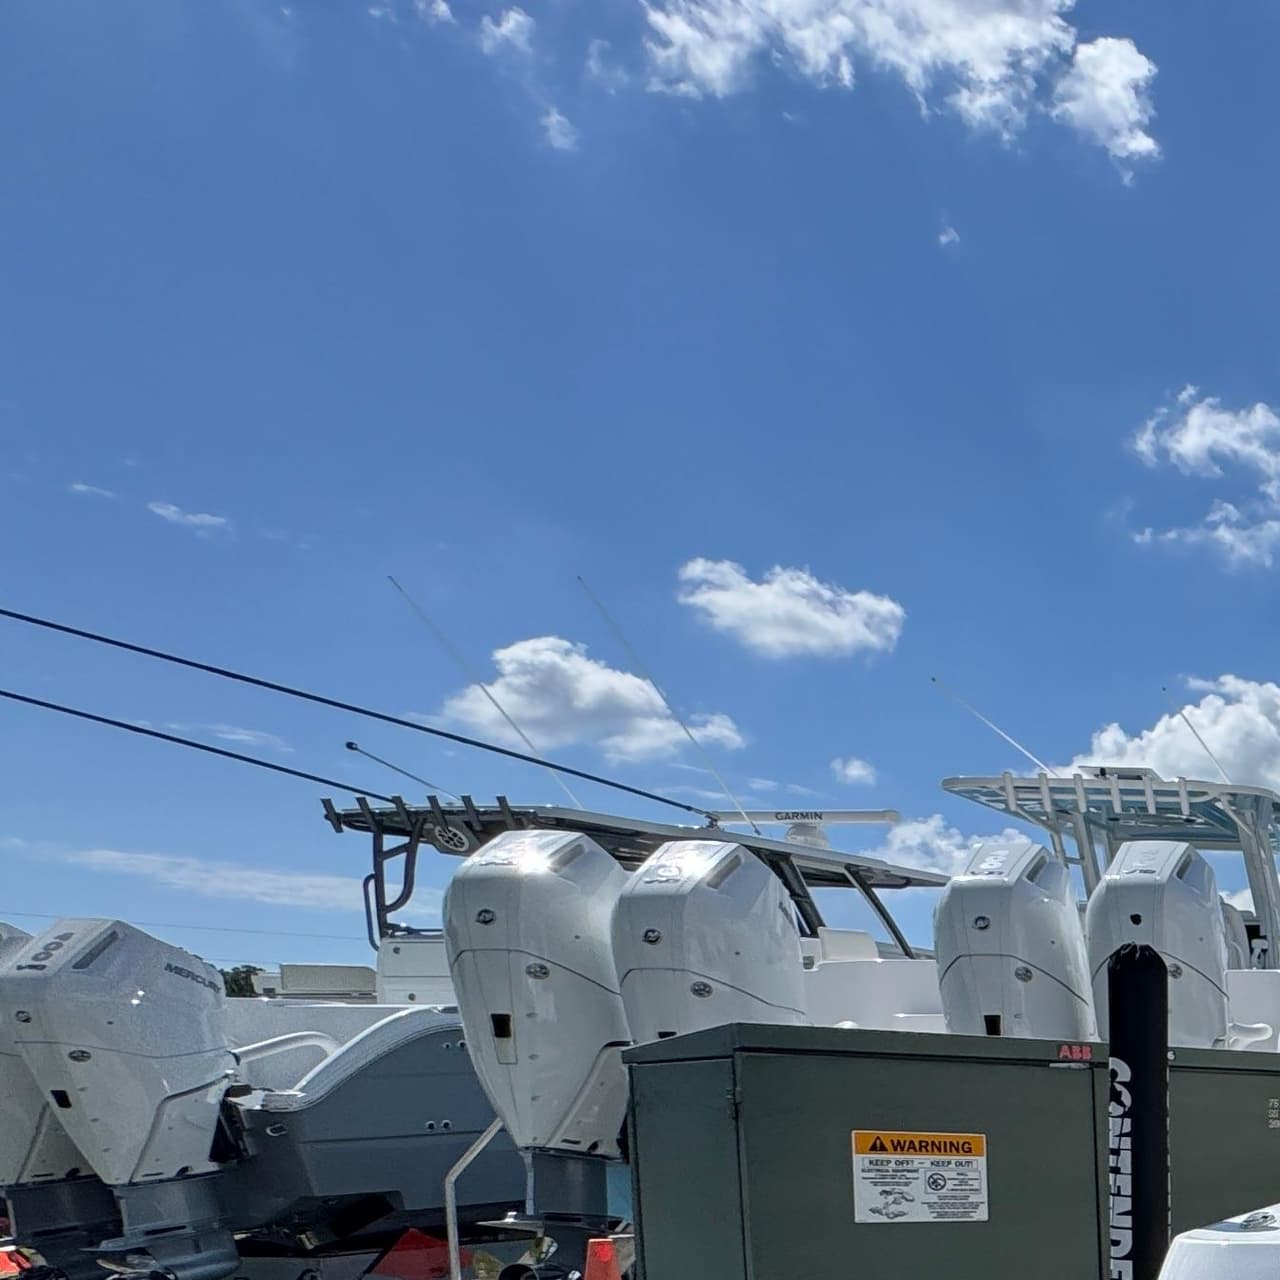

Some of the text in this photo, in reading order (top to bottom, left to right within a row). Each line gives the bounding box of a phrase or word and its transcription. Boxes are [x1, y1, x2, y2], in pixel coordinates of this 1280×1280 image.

[775, 811, 823, 821] GARMIN
[163, 962, 221, 993] MERCURY
[1059, 1044, 1093, 1061] ABB
[891, 1139, 973, 1154] WARNING
[930, 1160, 952, 1168] KEEP
[954, 1160, 973, 1168] OUT!
